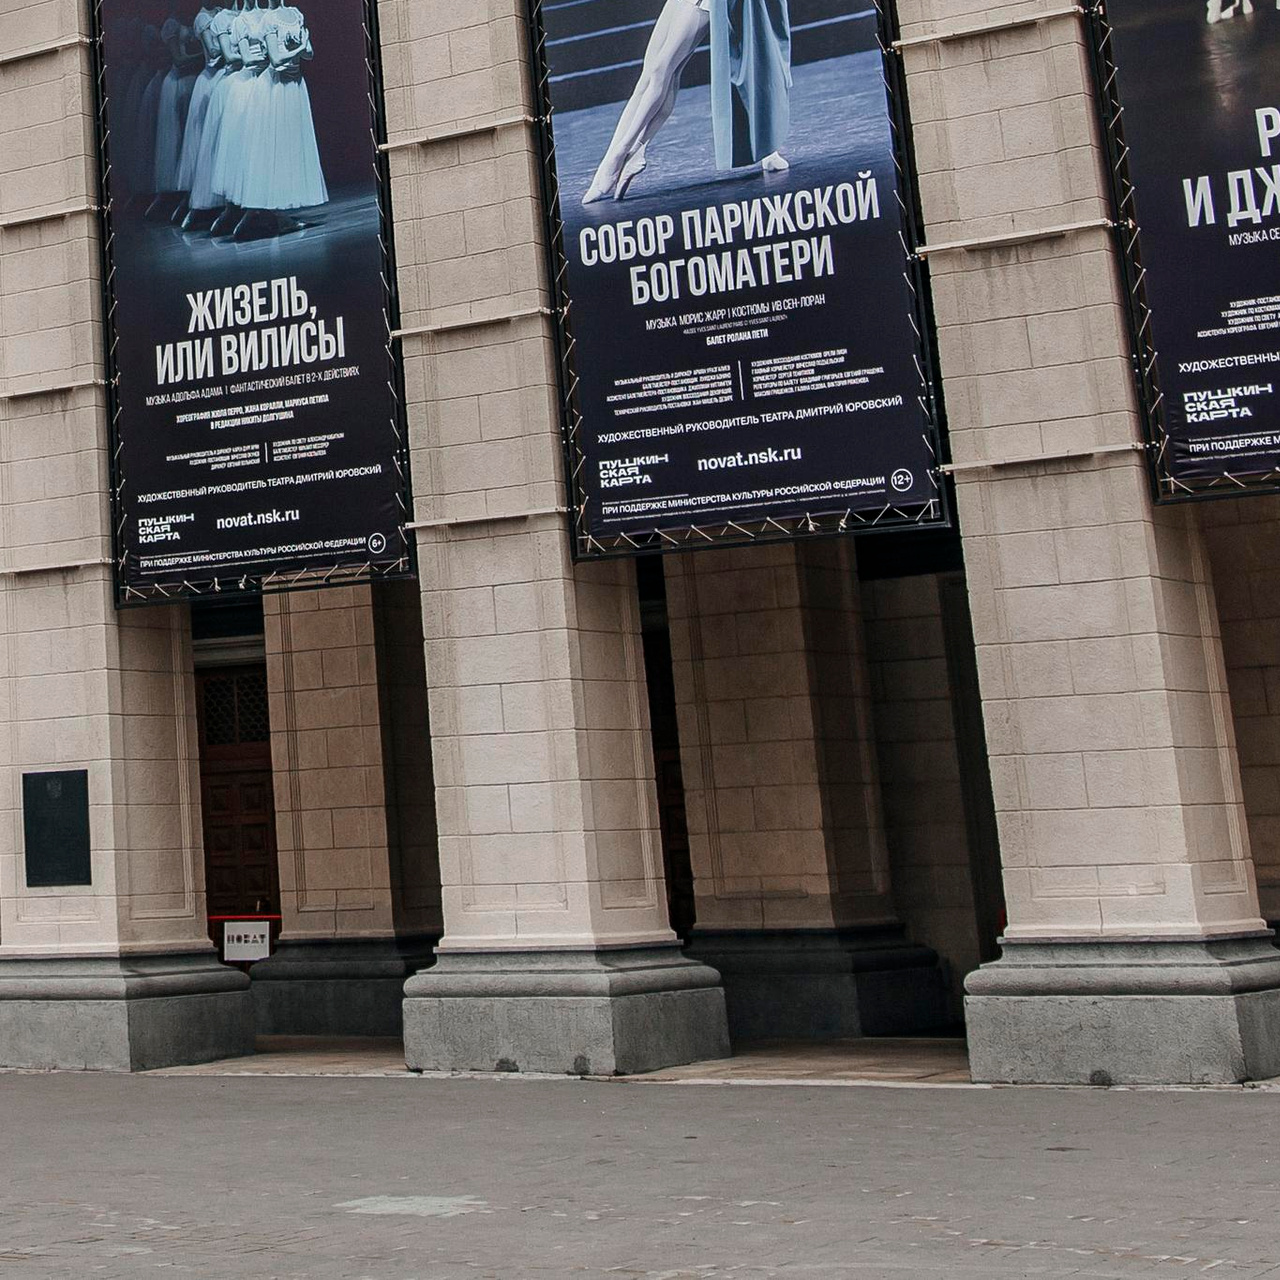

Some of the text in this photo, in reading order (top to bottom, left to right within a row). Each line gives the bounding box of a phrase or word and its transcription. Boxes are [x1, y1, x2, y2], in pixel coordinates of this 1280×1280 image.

[1183, 176, 1216, 228] И
[579, 170, 880, 266] СОБОР ПАРИЖСКОЙ
[1228, 229, 1268, 245] МУЗЫКА
[630, 234, 834, 305] БОГОМАТЕРИ
[186, 276, 316, 333] ЖИЗЕЛЬ,
[645, 316, 677, 330] МУЗЫКА
[679, 312, 704, 325] МОРИС
[704, 308, 726, 321] ЖАРР
[731, 302, 769, 317] КОСТЮМЫ
[782, 293, 825, 310] СЕН-ЛОРАН
[706, 328, 768, 345] БАЛЕТ РОЛАНА ПЕТИ
[156, 316, 345, 385] ИЛИ ВИЛИСЫ
[285, 373, 305, 386] БАЛЕТ
[1183, 383, 1273, 402] ПУШКИН
[1185, 398, 1235, 412] СКАЯ
[597, 395, 902, 443] ХУДОЖЕСТВЕННЫЙ РУКОВОДИТЕЛЬ ТЕАТРА ДМИТРИЙ ЮРОВСКИЙ
[1186, 407, 1252, 423] КАРТА
[1189, 443, 1209, 452] ПРИ
[1210, 436, 1272, 450] ПОДДЕРЖКЕ
[599, 453, 668, 469] ПУШКИН
[697, 447, 801, 470] novat.nsk.ru
[599, 466, 639, 478] СКАЯ
[892, 474, 911, 487] 12+
[137, 464, 381, 503] ХУДОЖЕСТВЕННЫЙ РУКОВОДИТЕЛЬ ТЕАТРА ДМИТРИЙ ЮРОВСКИЙ
[600, 474, 652, 488] КАРТА
[602, 506, 618, 514] ПРИ
[619, 500, 667, 513] ПОДДЕРЖКЕ
[668, 494, 731, 507] МИНИСТЕРСТВА
[732, 489, 773, 500] КУЛЬТУРЫ
[774, 481, 832, 495] РОССИЙСКОЙ
[832, 476, 885, 489] ФЕДЕРАЦИИ
[138, 513, 194, 527] ПУШКИН
[217, 509, 299, 529] novat.nsk.ru
[138, 524, 170, 535] СКАЯ
[139, 531, 180, 543] КАРТА
[153, 555, 192, 566] ПОДДЕРЖКЕ
[192, 550, 243, 562] МИНИСТЕРСТВА
[243, 547, 276, 556] КУЛЬТУРЫ
[277, 540, 323, 553] РОССИЙСКОЙ
[324, 537, 366, 548] ФЕДЕРАЦИИ
[372, 539, 381, 548] 6+
